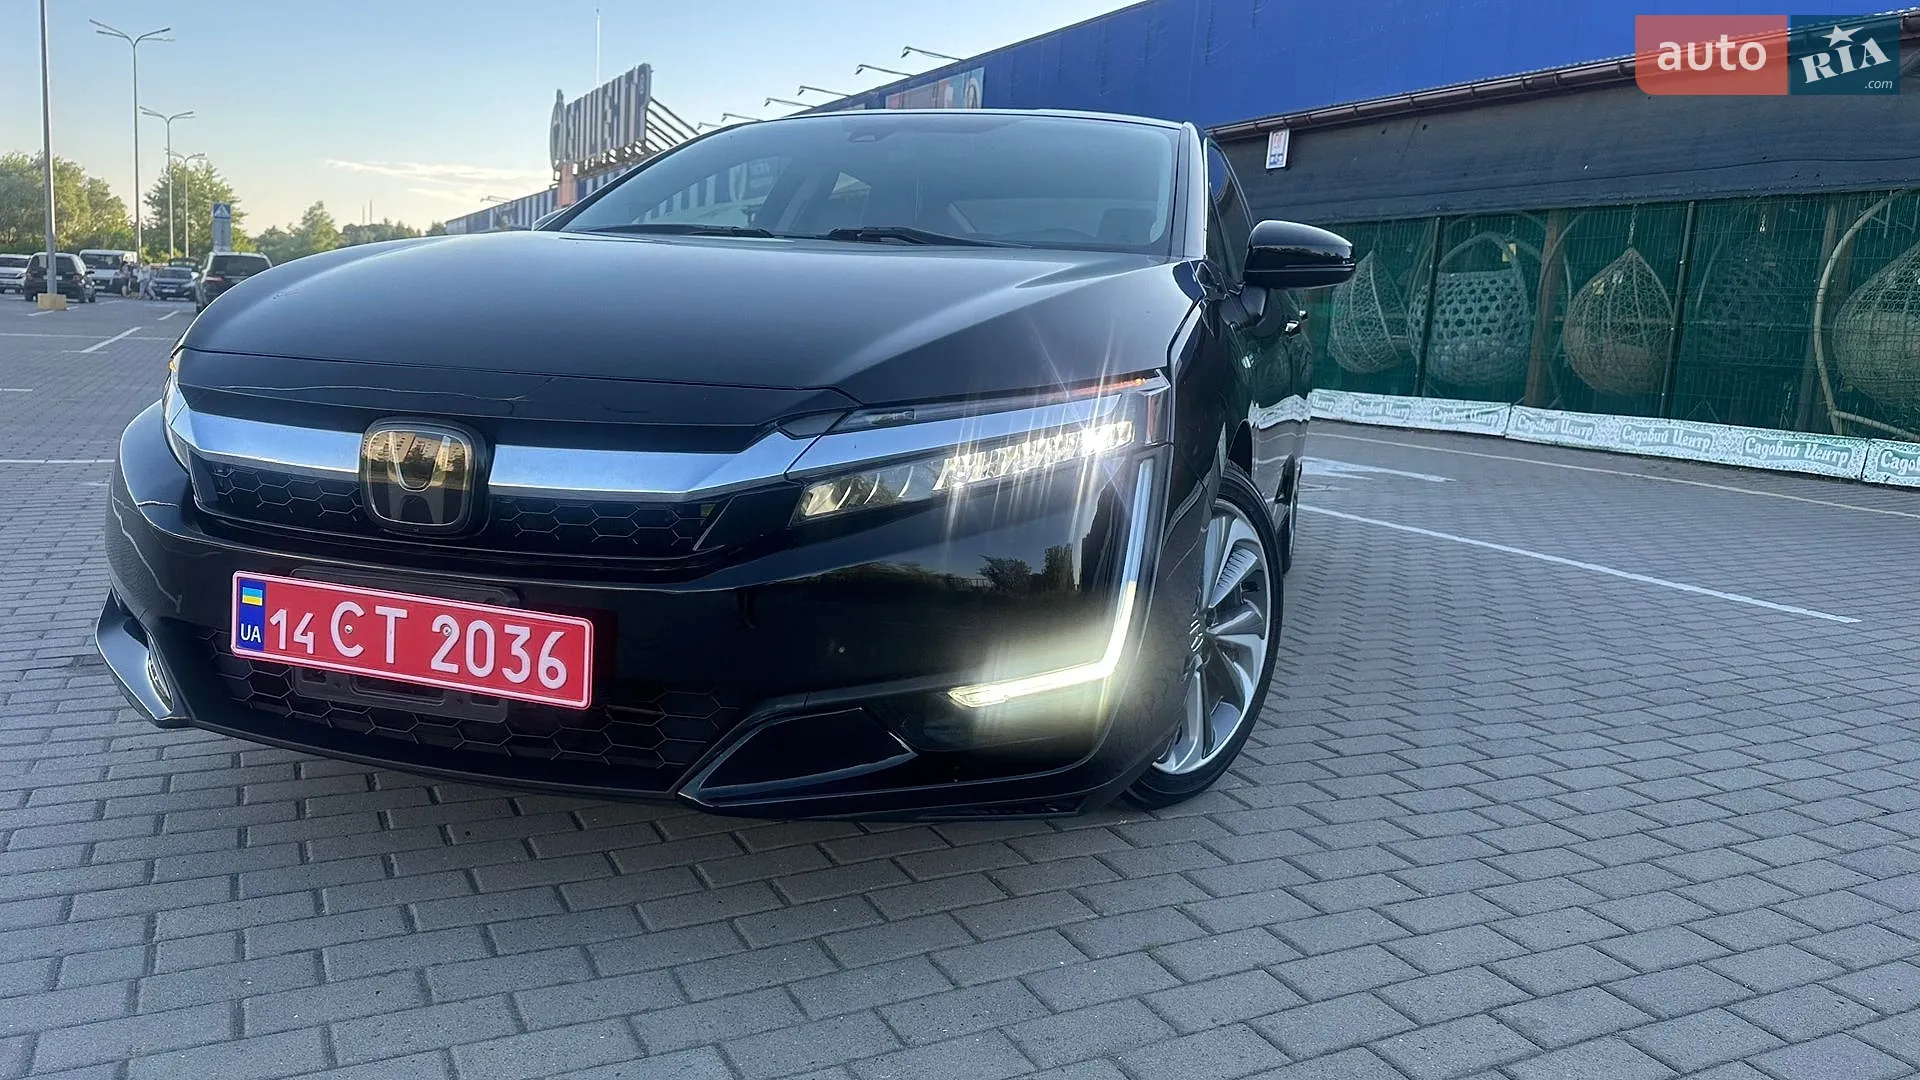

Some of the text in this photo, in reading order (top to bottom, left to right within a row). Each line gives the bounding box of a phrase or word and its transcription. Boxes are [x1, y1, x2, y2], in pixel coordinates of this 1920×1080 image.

[1673, 429, 1713, 452] Центр
[1744, 436, 1850, 468] Садовий Центр
[240, 623, 262, 643] UA
[269, 601, 567, 690] 14 CT 2036
